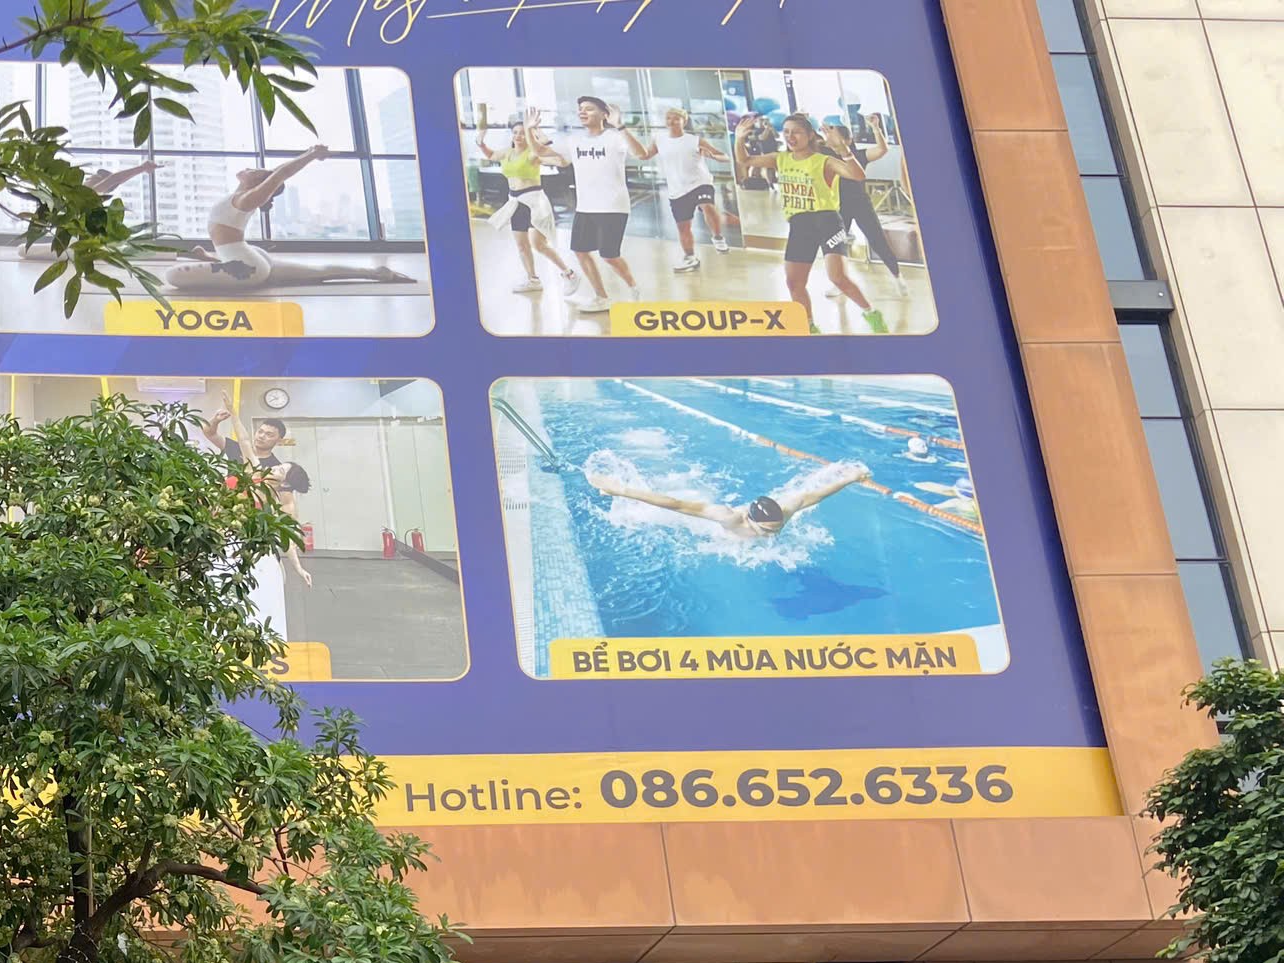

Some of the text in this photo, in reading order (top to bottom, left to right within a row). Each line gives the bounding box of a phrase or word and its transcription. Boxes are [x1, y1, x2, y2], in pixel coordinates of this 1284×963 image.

[783, 183, 815, 198] UMBA
[783, 195, 816, 210] PIRIT
[155, 308, 254, 332] YOGA
[633, 308, 786, 332] GROUP-X
[572, 640, 958, 676] BỂ BƠI 4 MÙA NƯỚC MẶN
[405, 764, 1014, 813] Hotline: 086.652.6336
